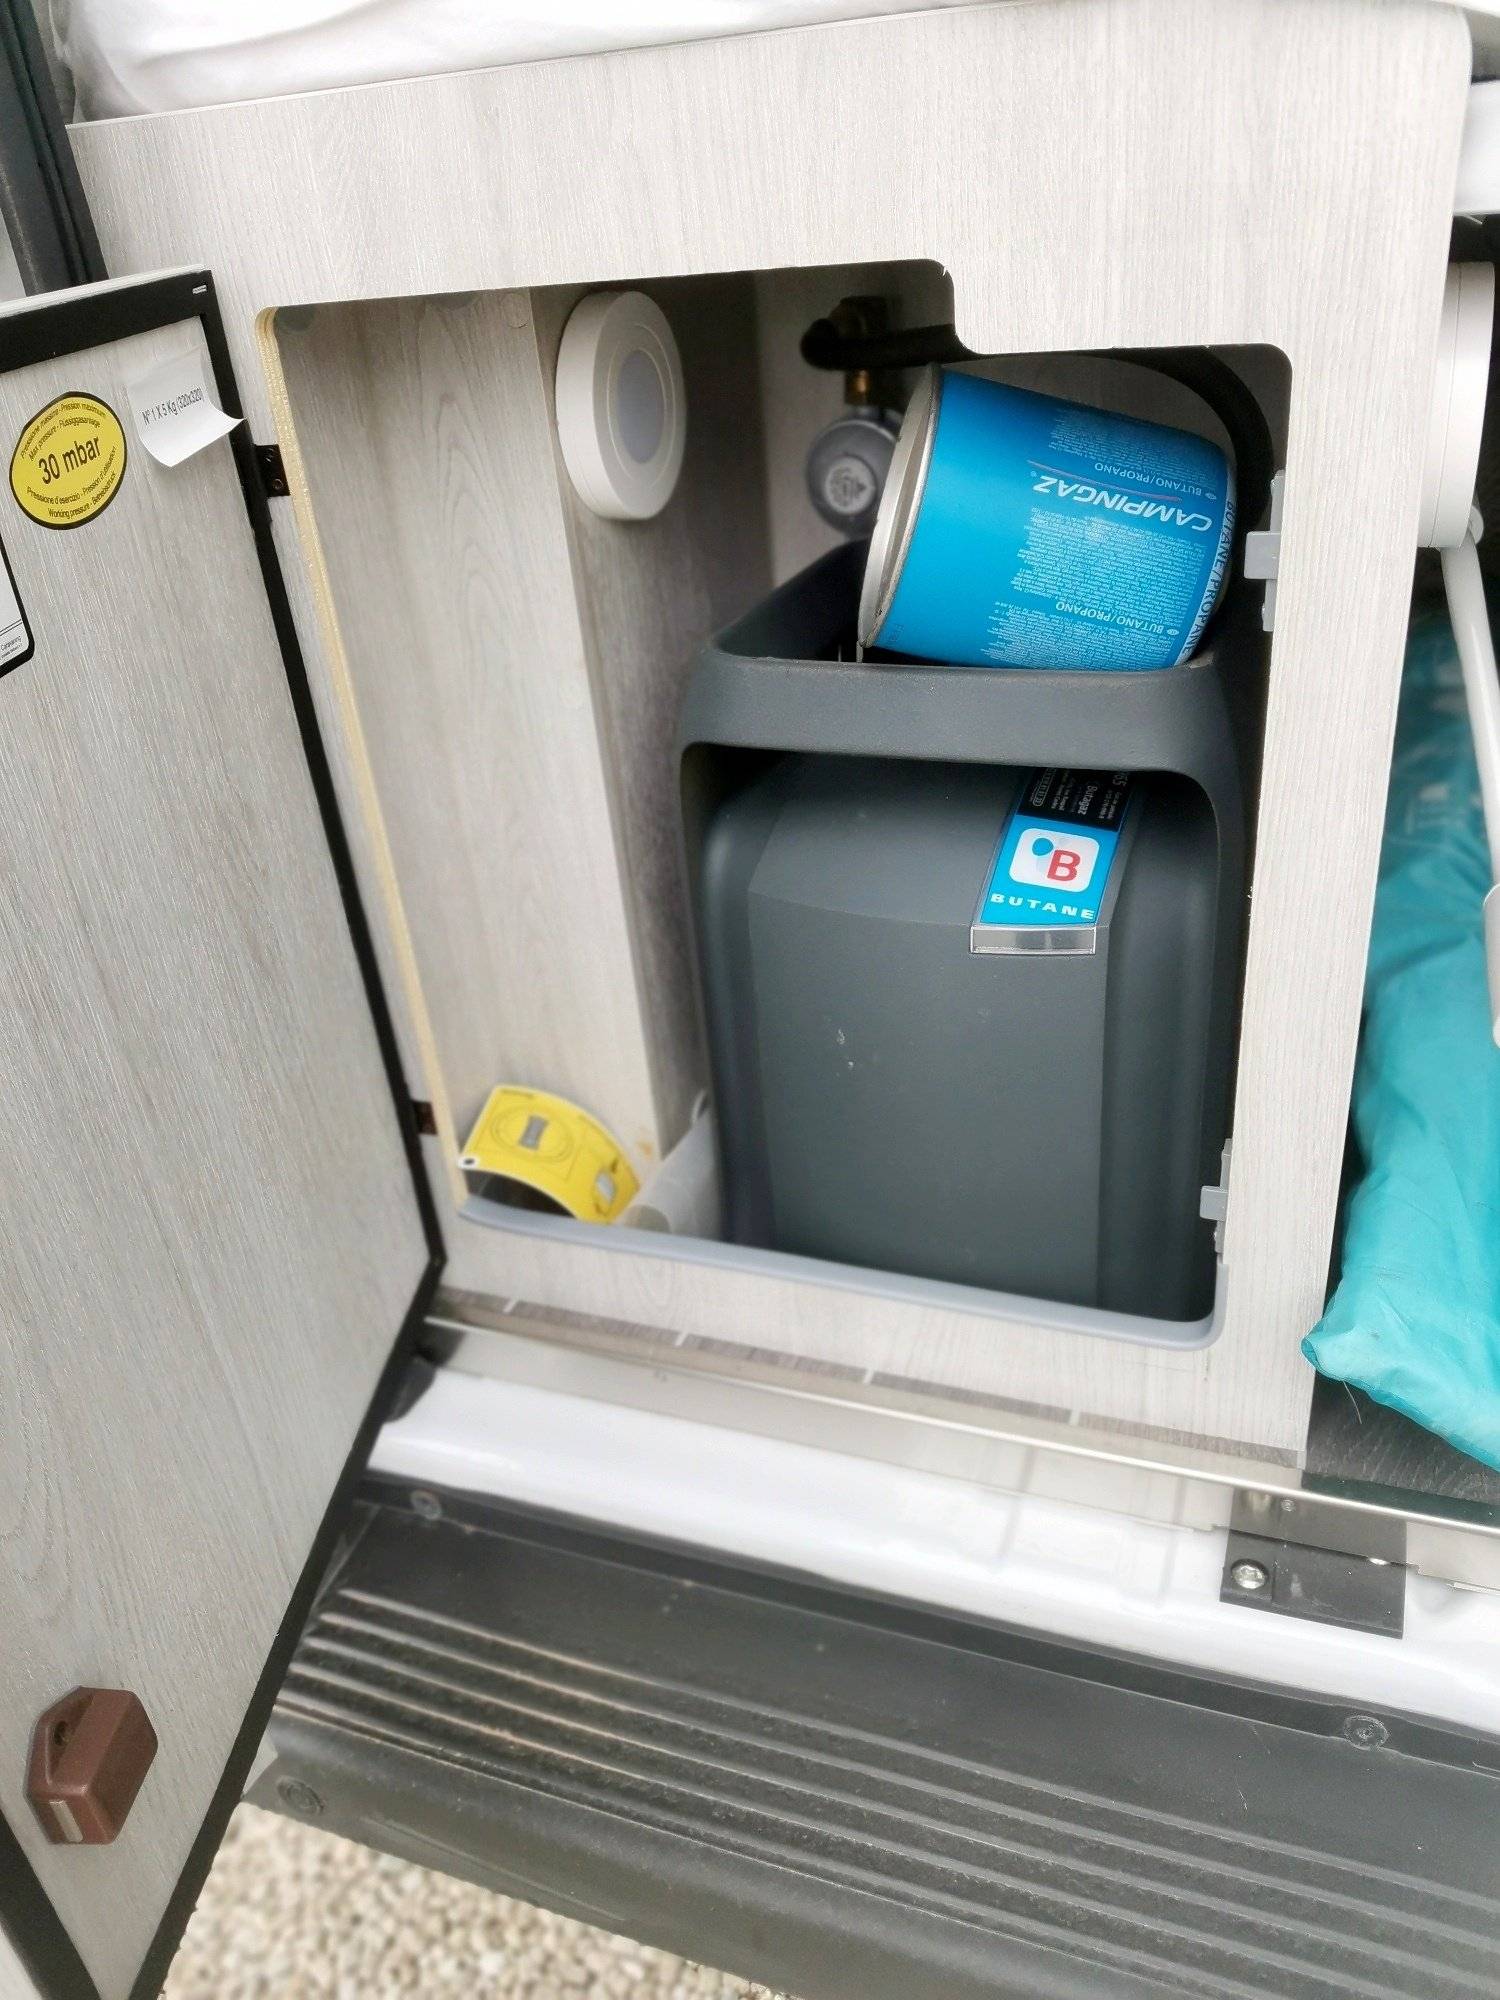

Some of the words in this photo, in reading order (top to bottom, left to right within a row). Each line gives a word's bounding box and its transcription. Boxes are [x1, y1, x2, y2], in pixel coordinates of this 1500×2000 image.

[167, 399, 178, 415] Kg
[38, 453, 61, 484] 30
[62, 436, 101, 473] mbar
[1093, 461, 1202, 497] BUTANO/PROPANO
[47, 506, 70, 520] Working
[70, 502, 90, 519] pressure
[1032, 476, 1213, 532] CAMPINGAZ
[1055, 601, 1165, 635] BUTANO/PROPANO
[1046, 849, 1082, 882] B
[990, 892, 1096, 920] BUTANE
